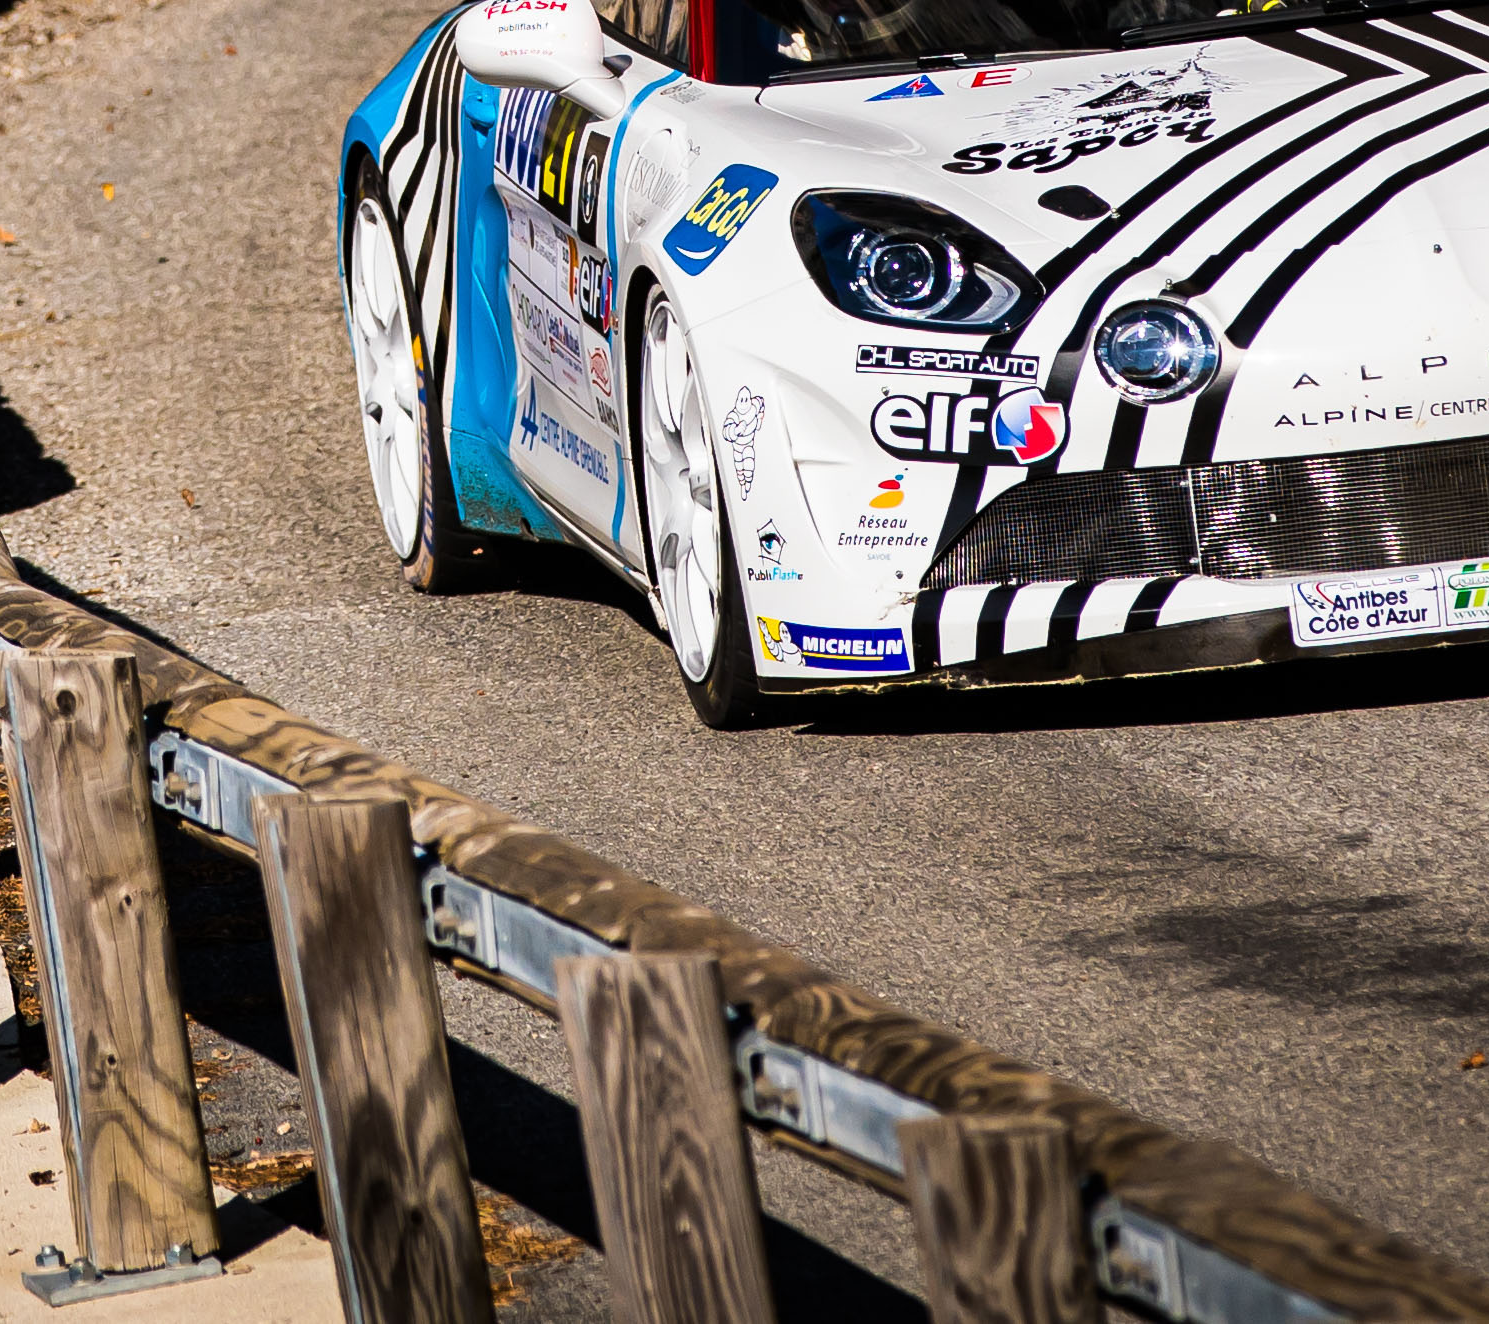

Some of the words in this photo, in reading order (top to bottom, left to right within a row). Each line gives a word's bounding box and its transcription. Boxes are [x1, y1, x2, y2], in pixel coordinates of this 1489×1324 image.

[485, 1, 568, 20] FLASH
[498, 22, 551, 33] publiflash.f
[970, 67, 1018, 89] E
[941, 118, 1217, 175] Sapey
[685, 176, 771, 242] CarGo!
[580, 258, 602, 319] elf
[857, 345, 905, 366] CHL
[908, 351, 980, 371] SPORT
[978, 355, 1038, 376] AUTO
[873, 394, 989, 454] elf
[858, 514, 908, 529] Réseau
[837, 532, 929, 549] Entreprendre
[867, 553, 892, 561] SAVOIE
[1333, 590, 1409, 612] Antibes
[1308, 612, 1360, 635] Côte
[1366, 607, 1429, 628] d'Azur
[802, 636, 904, 656] MICHELIN
